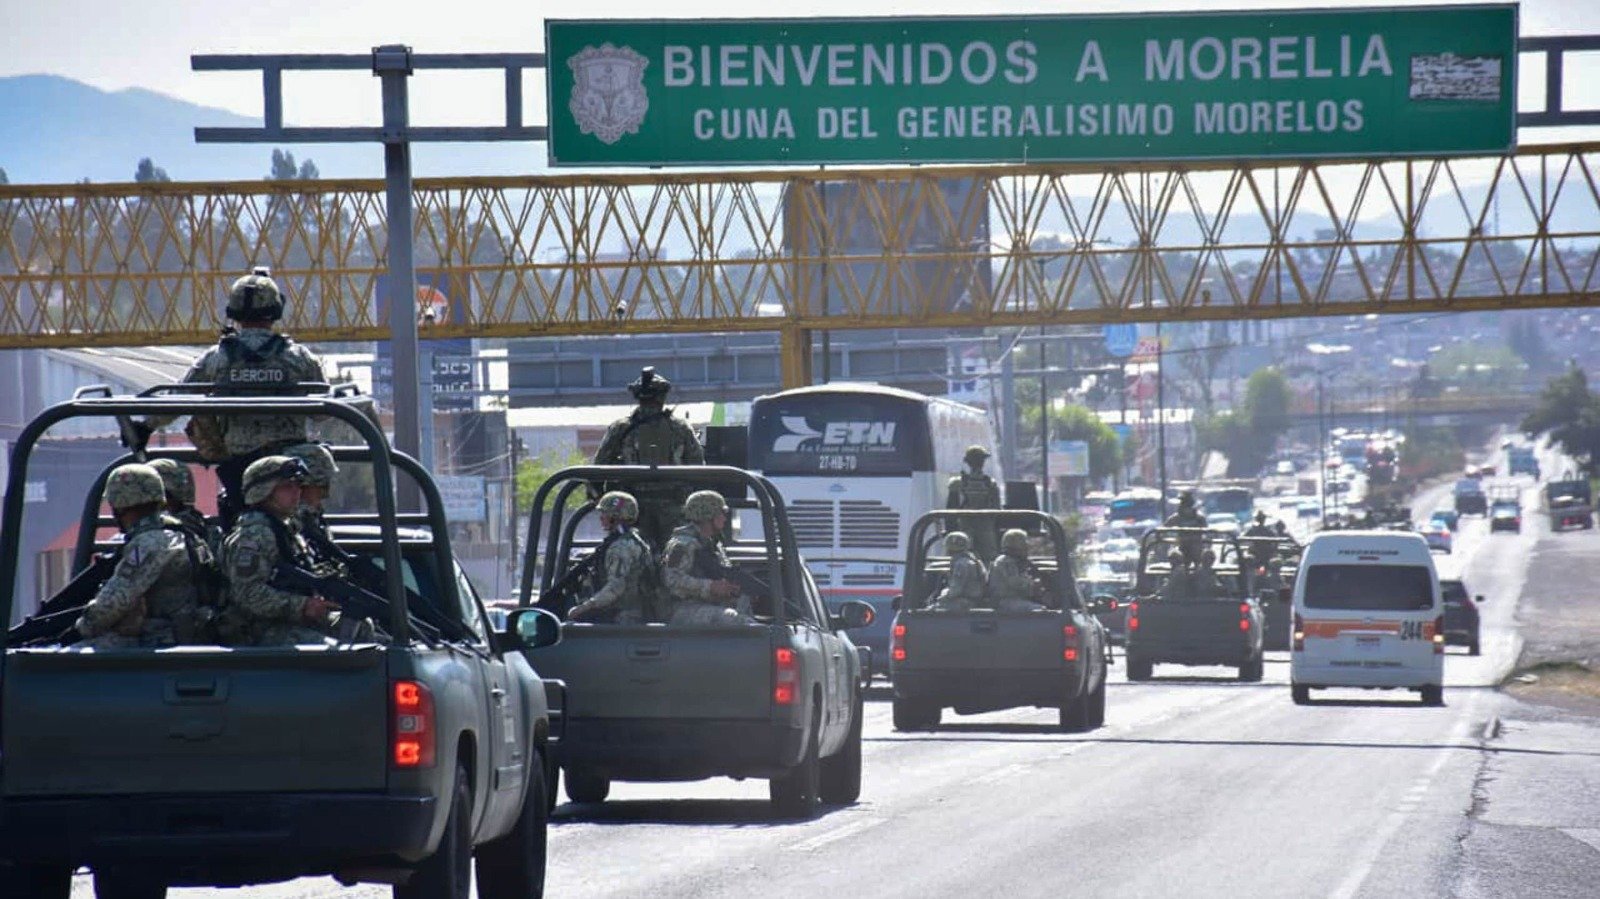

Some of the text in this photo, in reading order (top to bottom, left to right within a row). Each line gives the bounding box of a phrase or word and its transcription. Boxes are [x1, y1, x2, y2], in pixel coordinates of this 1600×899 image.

[664, 36, 1393, 87] BIENVENIDOS A MORELIA
[694, 100, 1364, 140] CUNA DEL GENERALISIMO MORELOS
[230, 368, 284, 382] EJERCITO
[823, 421, 897, 444] ETN
